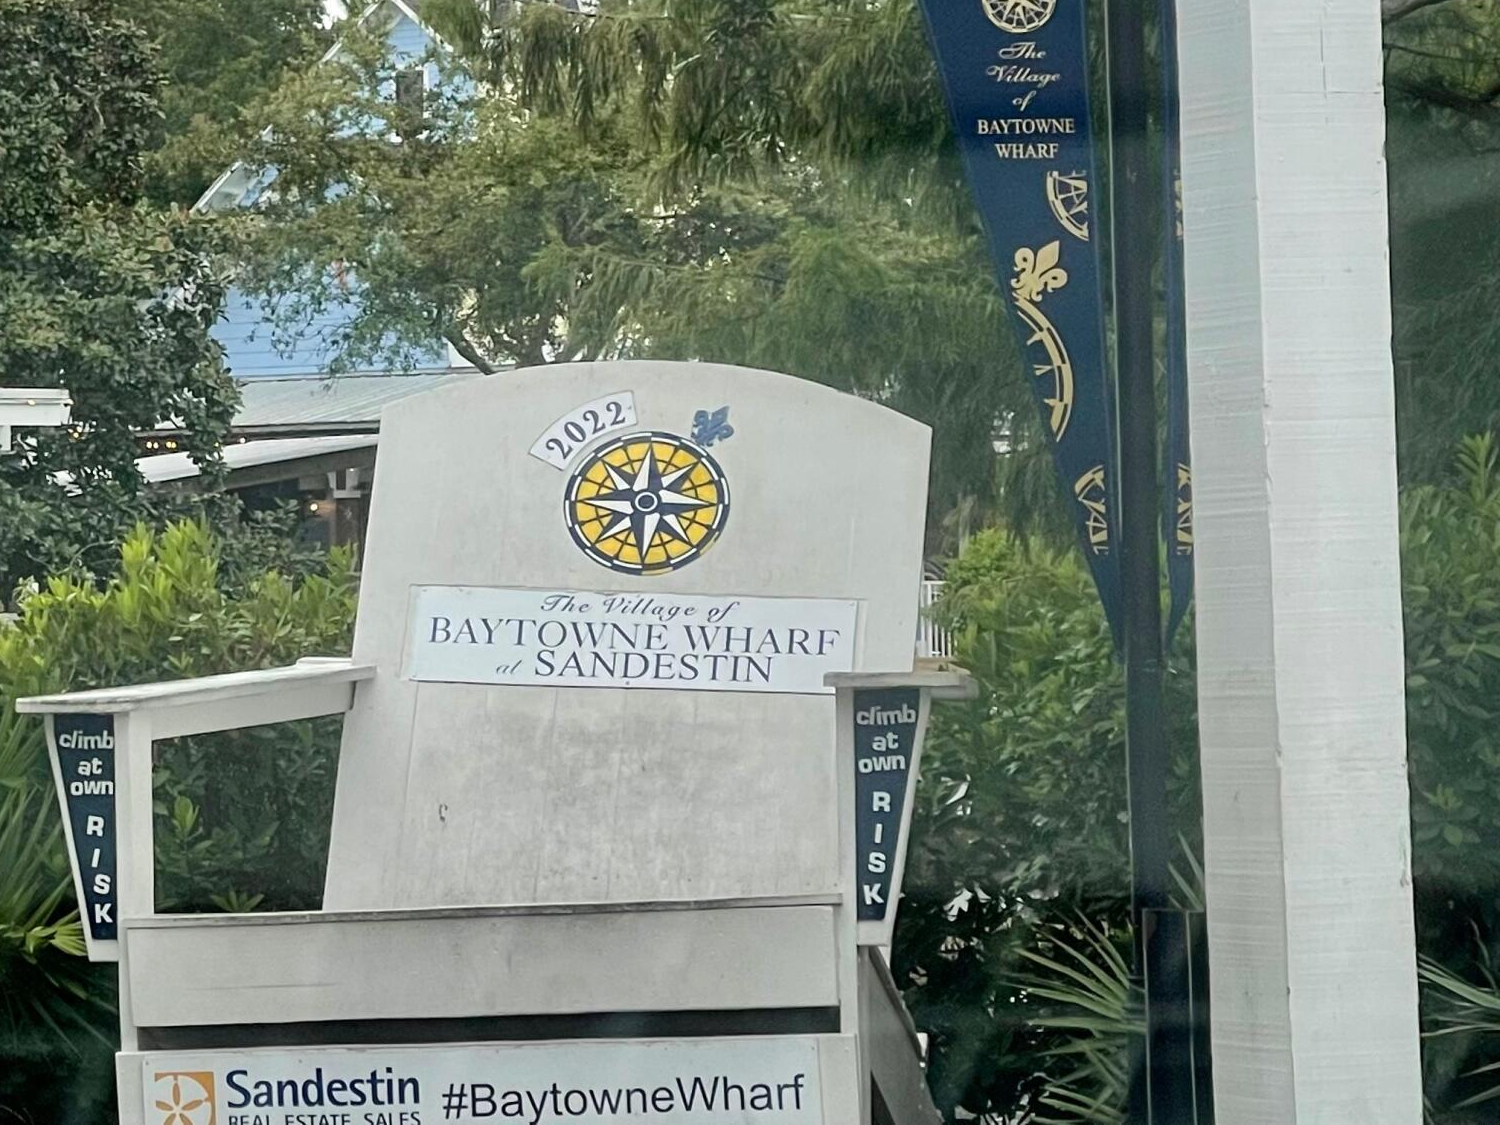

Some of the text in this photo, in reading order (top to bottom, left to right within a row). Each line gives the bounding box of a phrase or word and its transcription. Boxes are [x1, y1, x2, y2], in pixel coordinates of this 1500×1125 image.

[998, 41, 1047, 59] The
[986, 65, 1061, 88] Village
[1011, 90, 1037, 111] of
[977, 118, 1076, 134] BAYTOWNE
[994, 143, 1059, 158] WHARF
[545, 401, 626, 460] 2022
[540, 594, 741, 623] The Village of
[428, 616, 842, 656] BAYTOWNE WHARF
[534, 649, 775, 683] SANDESTIN
[856, 704, 916, 725] climb
[59, 730, 114, 750] climb
[872, 732, 899, 751] at
[78, 757, 103, 776] at
[858, 755, 906, 774] own
[70, 780, 114, 796] own
[863, 791, 891, 906] RISK
[86, 815, 113, 924] RISK
[226, 1067, 805, 1125] Sandestin #BaytowneWharf
[228, 1111, 421, 1125] REAL ESTATE SALES
